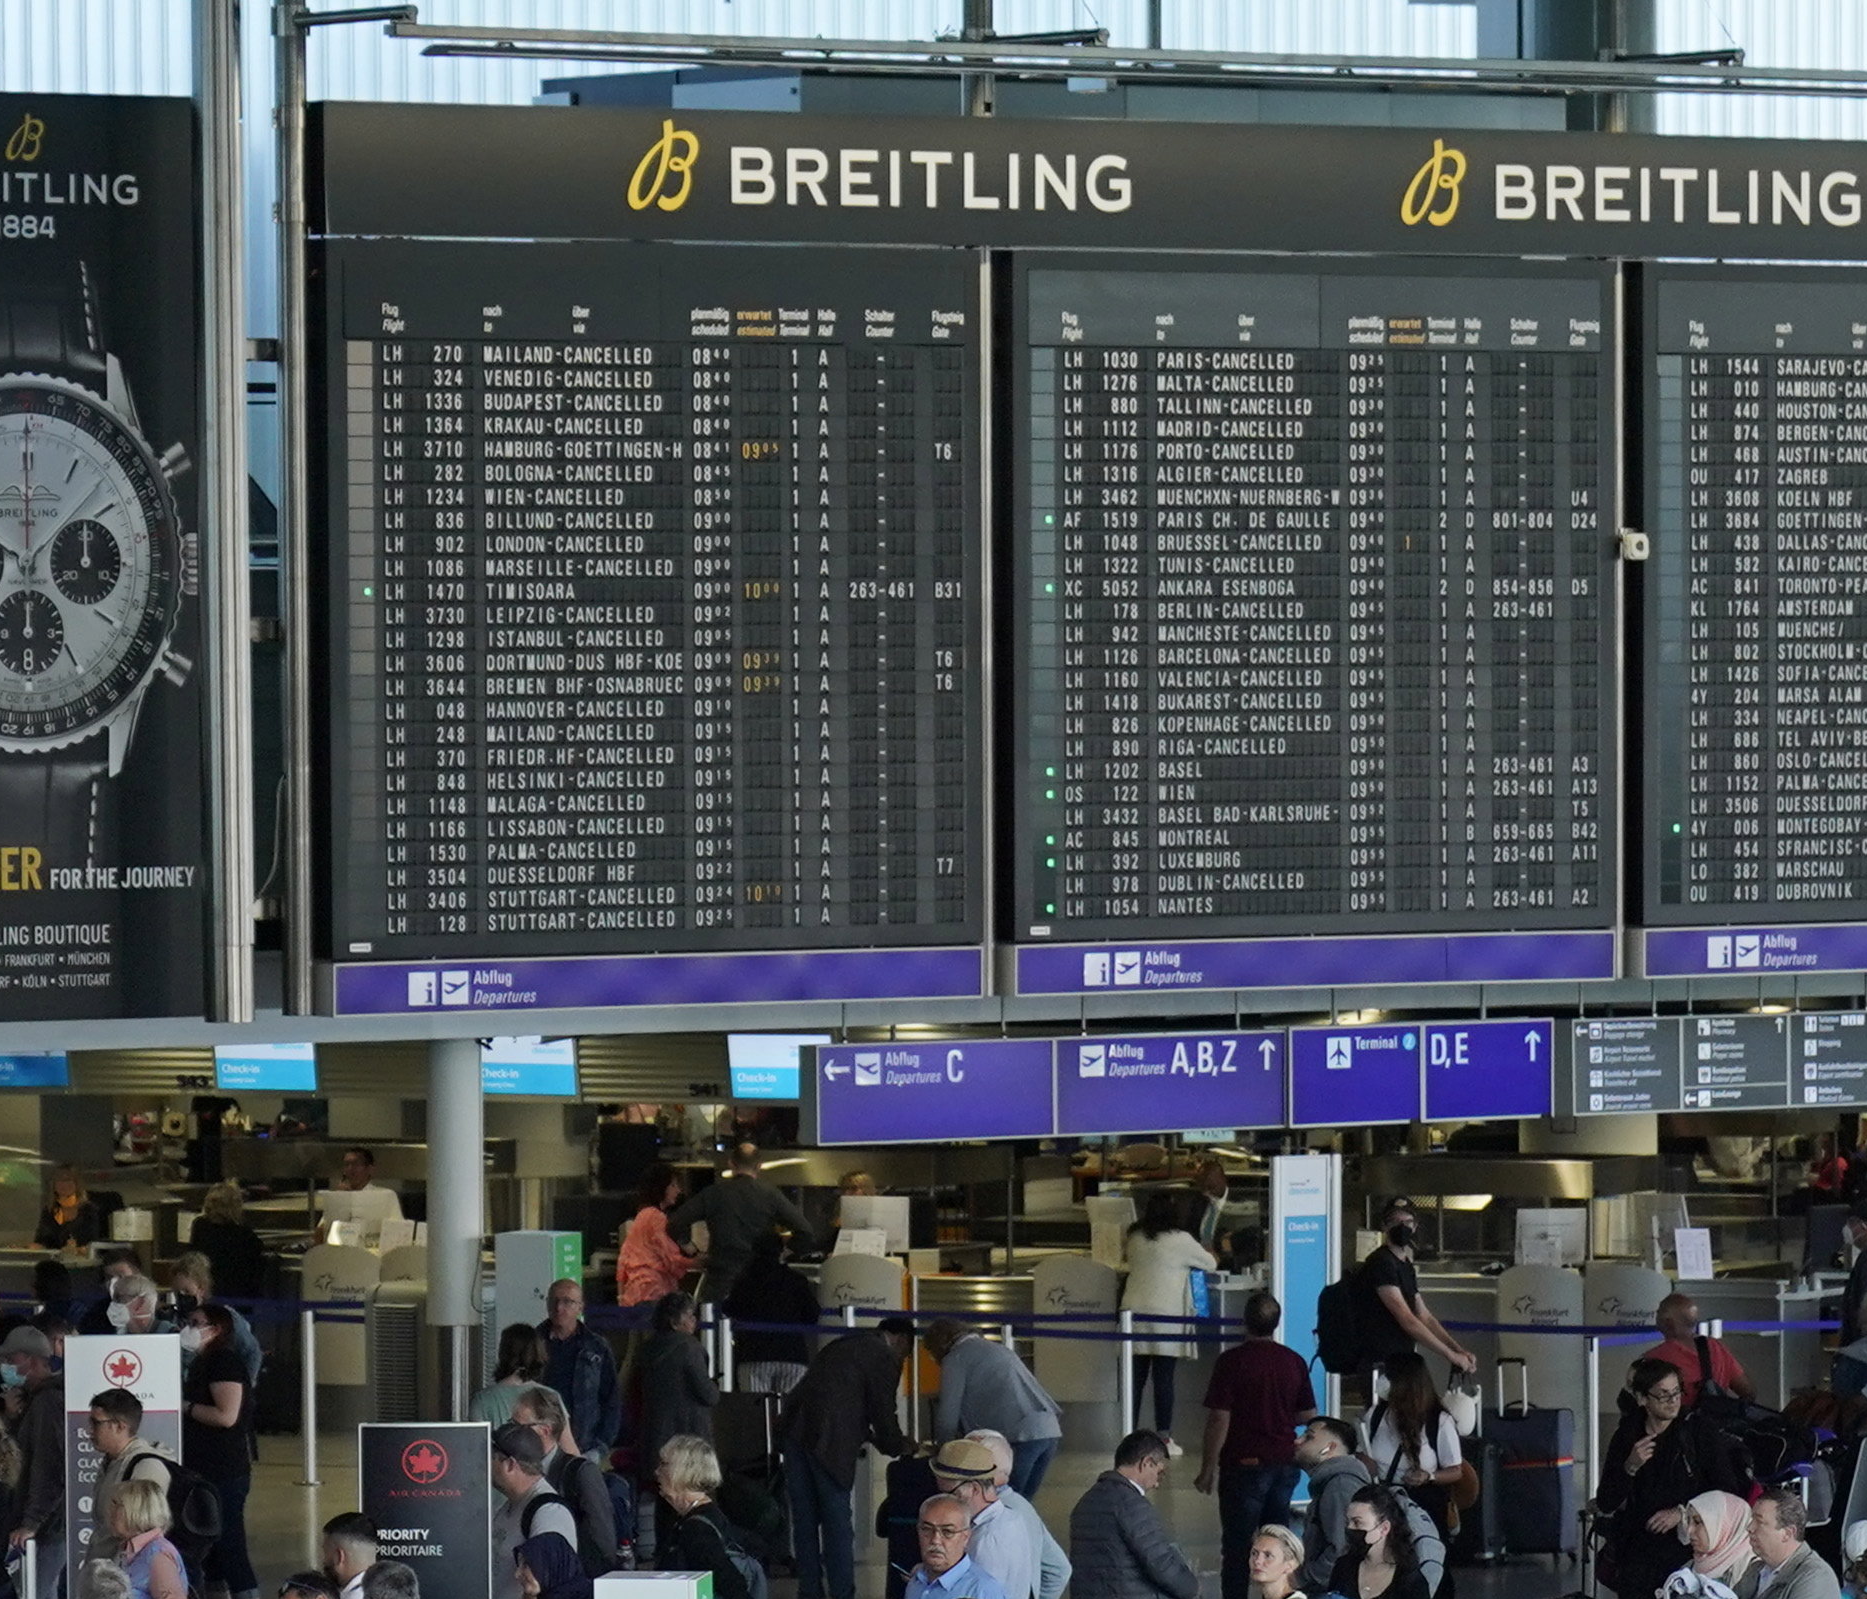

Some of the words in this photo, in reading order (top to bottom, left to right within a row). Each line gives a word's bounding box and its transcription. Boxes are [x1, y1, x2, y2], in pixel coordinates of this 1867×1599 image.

[731, 147, 1131, 212] BREITLING
[1496, 165, 1860, 226] BREITLING
[384, 346, 401, 361] LH
[434, 346, 461, 362] 270
[484, 346, 652, 364] MAILAND-CANCELLED
[1065, 352, 1082, 367] LH
[1104, 352, 1137, 368] 1030
[1158, 352, 1293, 370] PARIS-CANCELLED
[1691, 359, 1707, 374] LH
[1728, 359, 1758, 374] 1544
[1064, 512, 1081, 527] AF
[1104, 512, 1137, 528] 1519
[1158, 512, 1202, 528] PARIS
[1250, 512, 1266, 528] DE
[1277, 512, 1329, 528] GAULLE
[386, 584, 404, 600] LH
[428, 583, 464, 599] 1470
[487, 583, 574, 599] TIMISOARA
[850, 582, 913, 598] 263-461
[935, 582, 960, 598] B31
[1066, 832, 1083, 848] AC
[1113, 831, 1138, 847] 845
[1159, 830, 1229, 846] MONTREAL
[1494, 824, 1553, 840] 659-665
[1572, 823, 1596, 838] B42
[51, 869, 82, 889] FOR
[85, 867, 117, 888] THE
[121, 867, 194, 888] JOURNEY
[35, 924, 110, 945] BOUTIQUE
[1763, 935, 1796, 950] Abflug
[5, 954, 54, 966] FRANKFURT
[68, 951, 110, 965] MÜNCHEN
[1145, 951, 1180, 967] Abflug
[1764, 953, 1817, 968] Departures
[23, 974, 47, 988] KÖLN
[59, 974, 110, 987] STUTTGART
[474, 970, 512, 987] Abflug
[1145, 970, 1202, 986] Departures
[474, 990, 536, 1006] Departures
[1355, 1036, 1397, 1050] Terminal
[1432, 1033, 1468, 1068] D,E
[885, 1052, 919, 1068] Abflug
[1109, 1044, 1143, 1060] Abflug
[1171, 1041, 1236, 1077] A,B,Z
[222, 1064, 260, 1073] Check-in
[947, 1050, 963, 1082] C
[1109, 1063, 1165, 1078] Departures
[737, 1072, 777, 1082] Check-in
[886, 1071, 941, 1086] Departures
[389, 1488, 409, 1498] AIR
[413, 1488, 462, 1498] CANADA
